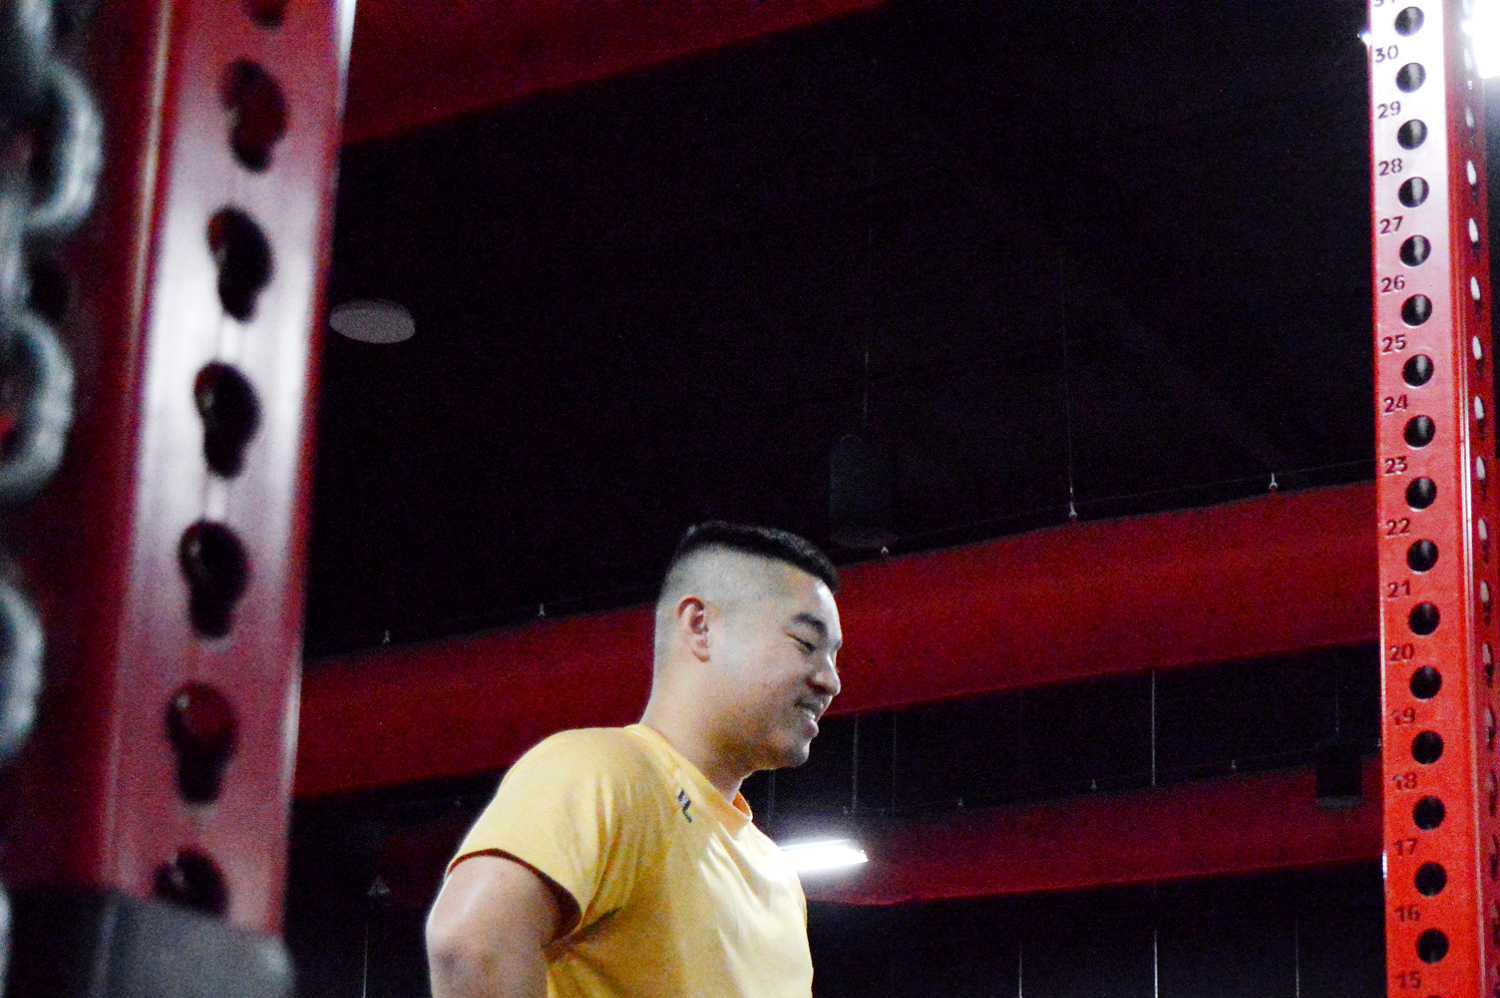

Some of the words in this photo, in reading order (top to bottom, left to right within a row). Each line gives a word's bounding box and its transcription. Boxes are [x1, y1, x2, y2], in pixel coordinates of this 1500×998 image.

[1375, 45, 1399, 63] 30
[1378, 101, 1401, 119] 29
[1378, 158, 1403, 176] 28
[1380, 216, 1403, 234] 27
[1381, 275, 1405, 293] 26
[1382, 335, 1406, 353] 25
[1383, 394, 1408, 414] 24
[1385, 456, 1407, 475] 23
[1386, 518, 1410, 536] 22
[1387, 581, 1411, 599] 21
[1389, 643, 1414, 662] 20
[1391, 707, 1416, 726] 19
[1393, 771, 1417, 790] 18
[1394, 838, 1417, 856] 17
[1395, 906, 1421, 923] 16
[1397, 971, 1422, 990] 15
